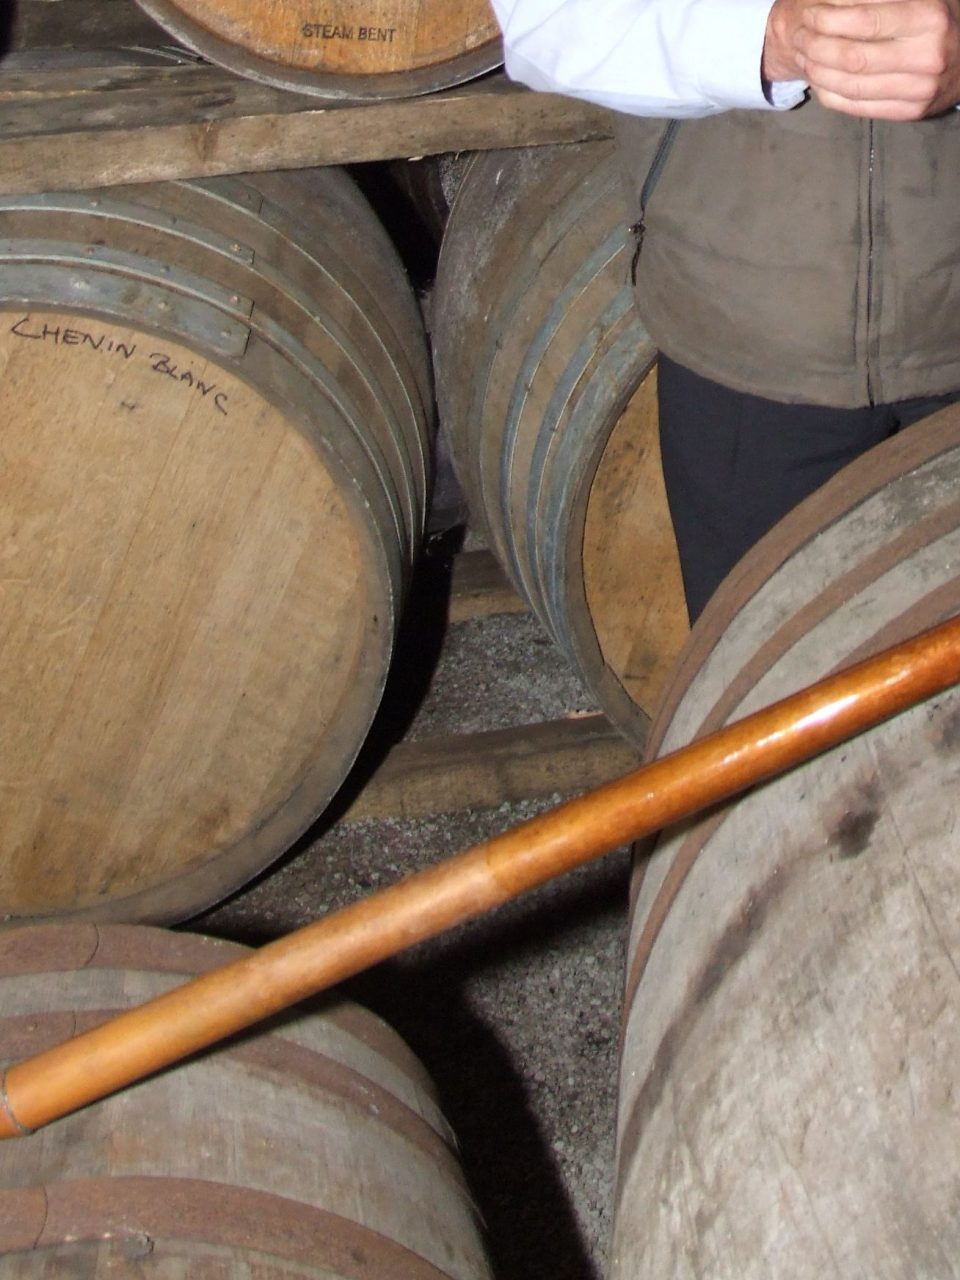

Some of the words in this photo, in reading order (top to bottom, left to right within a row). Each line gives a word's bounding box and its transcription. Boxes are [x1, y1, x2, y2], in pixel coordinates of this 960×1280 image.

[302, 23, 354, 41] STEAM
[357, 25, 397, 43] BENT
[11, 317, 137, 359] CHENIN
[149, 351, 229, 416] BLANC
